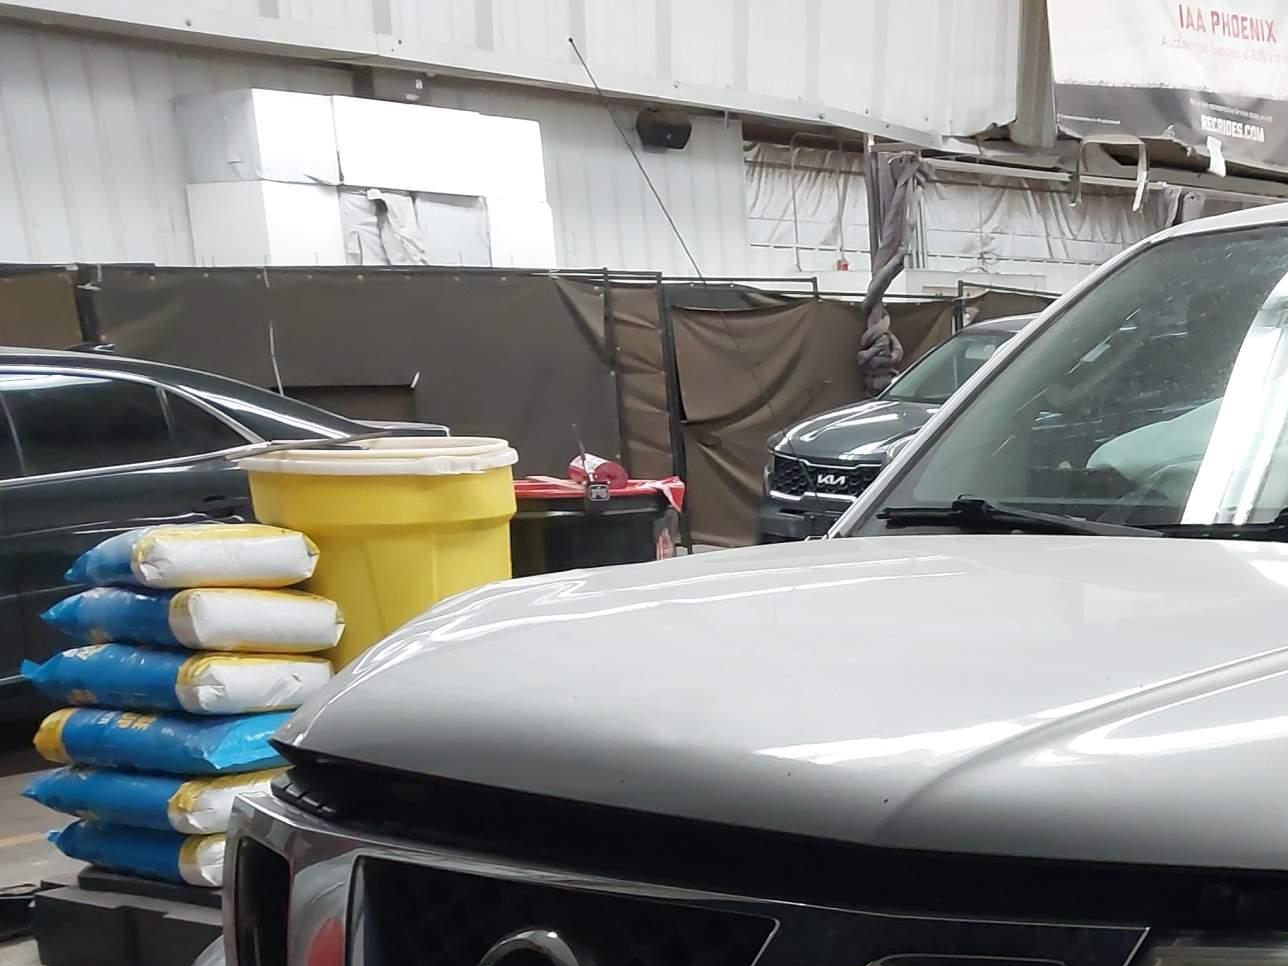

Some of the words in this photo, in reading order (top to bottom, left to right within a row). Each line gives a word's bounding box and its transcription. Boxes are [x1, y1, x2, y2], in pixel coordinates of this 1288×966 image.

[1178, 3, 1206, 33] IAA
[1210, 10, 1278, 44] PHOENIX
[817, 474, 846, 485] KIA
